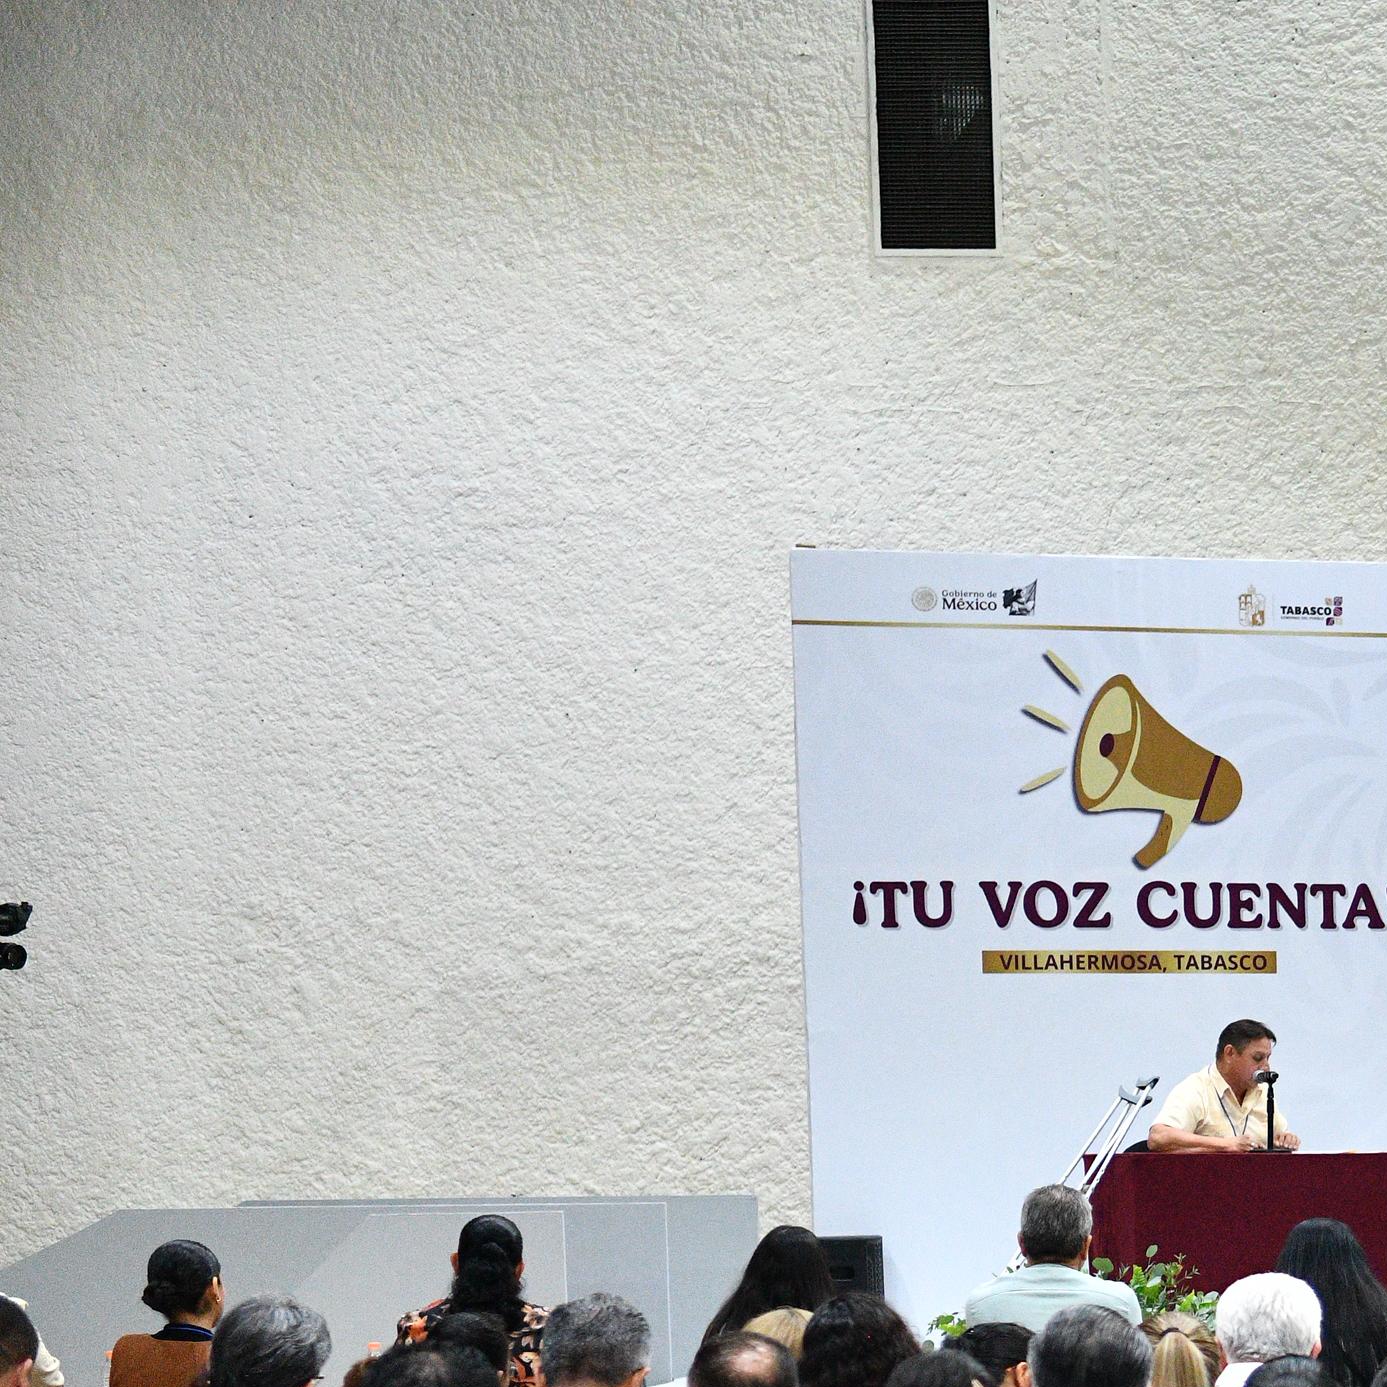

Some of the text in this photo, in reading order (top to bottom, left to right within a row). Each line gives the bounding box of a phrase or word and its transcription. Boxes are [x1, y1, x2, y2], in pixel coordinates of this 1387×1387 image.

[941, 589, 997, 600] Gobierno de
[942, 597, 998, 611] México
[1280, 605, 1332, 616] TABASCO
[852, 880, 954, 929] ¡TU
[978, 880, 1112, 929] VOZ
[999, 953, 1268, 973] VILLAHERMOSA, TABASCO
